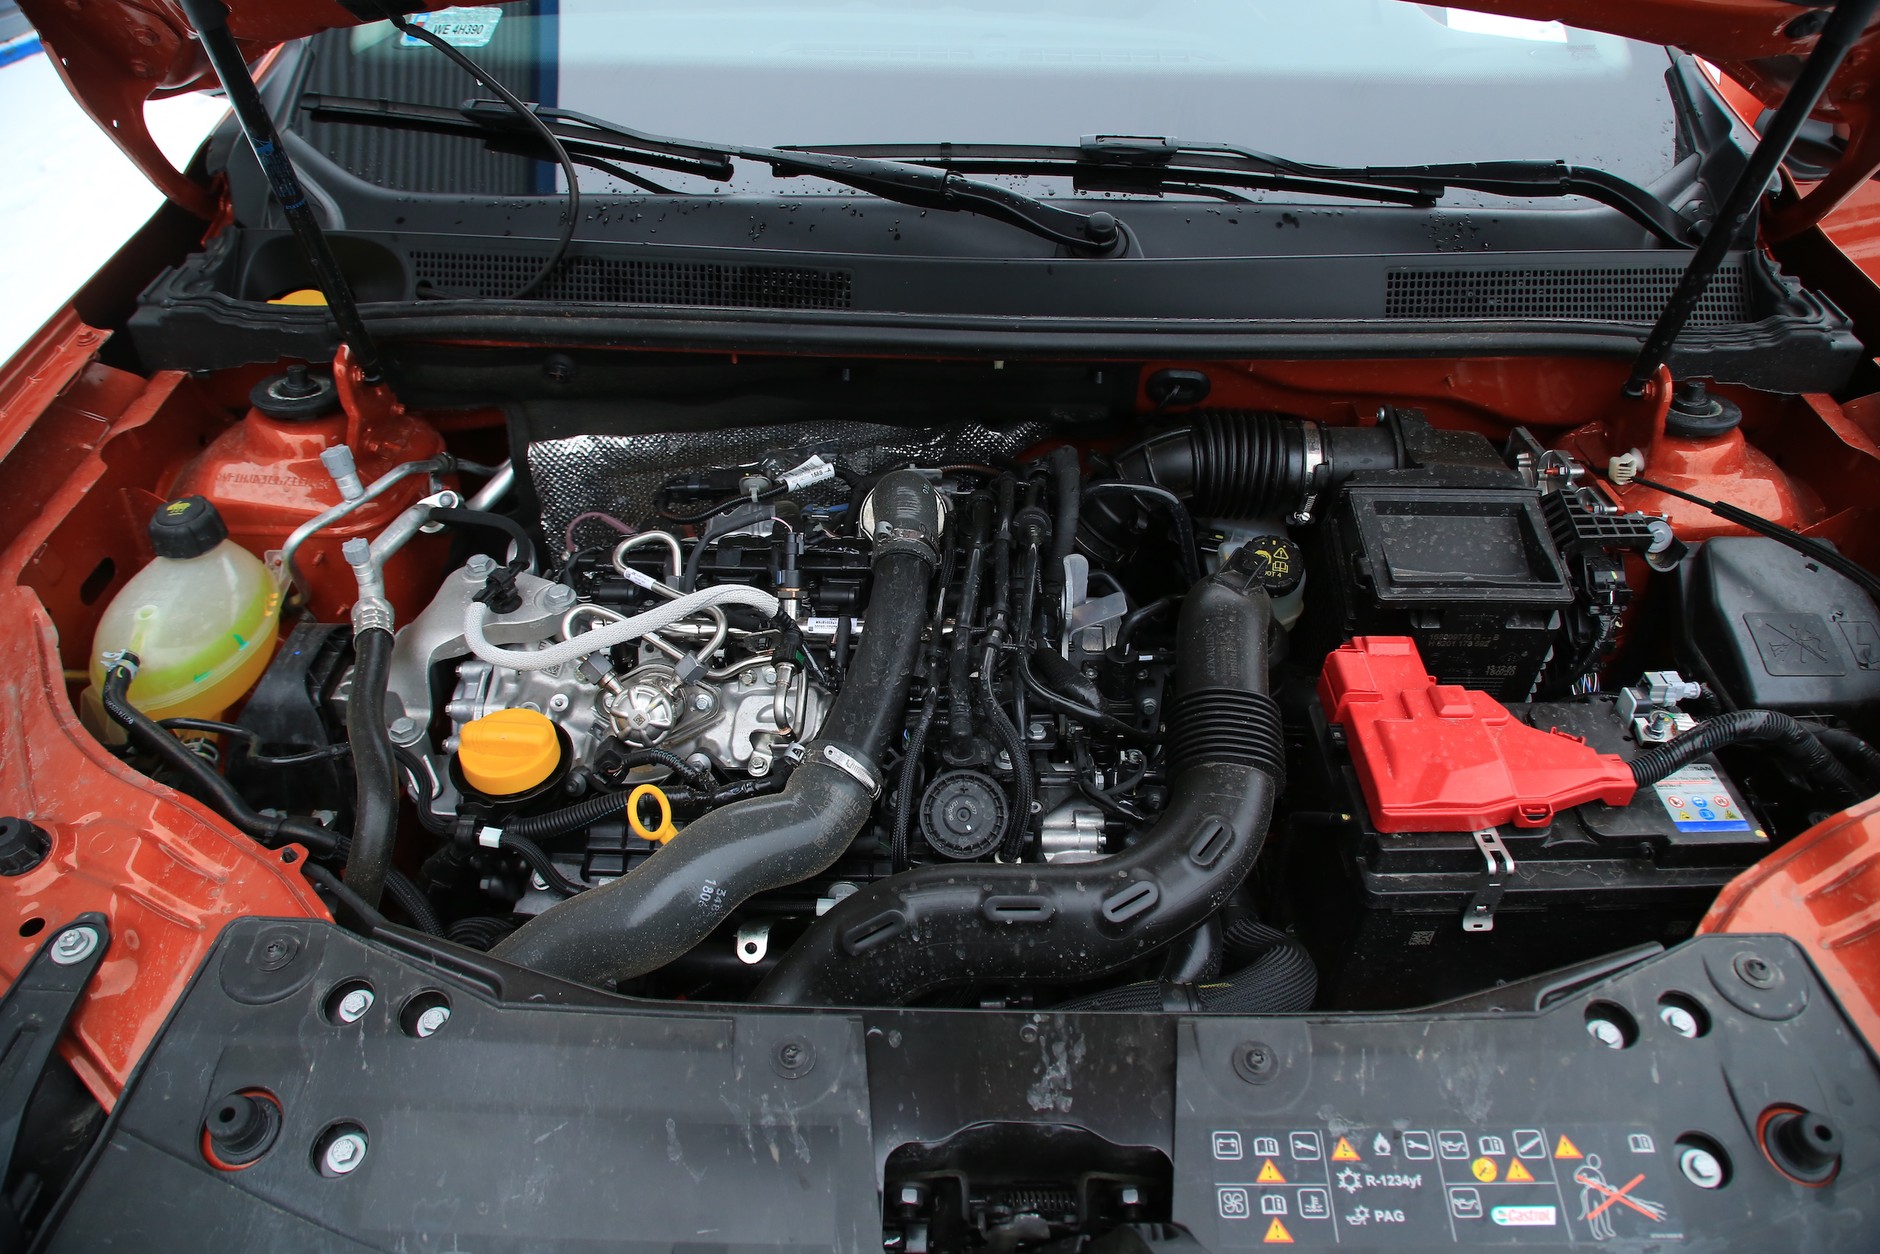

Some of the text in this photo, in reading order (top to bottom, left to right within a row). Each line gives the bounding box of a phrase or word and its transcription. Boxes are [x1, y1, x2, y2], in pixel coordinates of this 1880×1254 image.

[433, 24, 484, 35] WE 4H390
[1365, 1174, 1422, 1189] R-1234yf
[1374, 1209, 1406, 1223] PAG
[1508, 1209, 1550, 1222] Castrol
